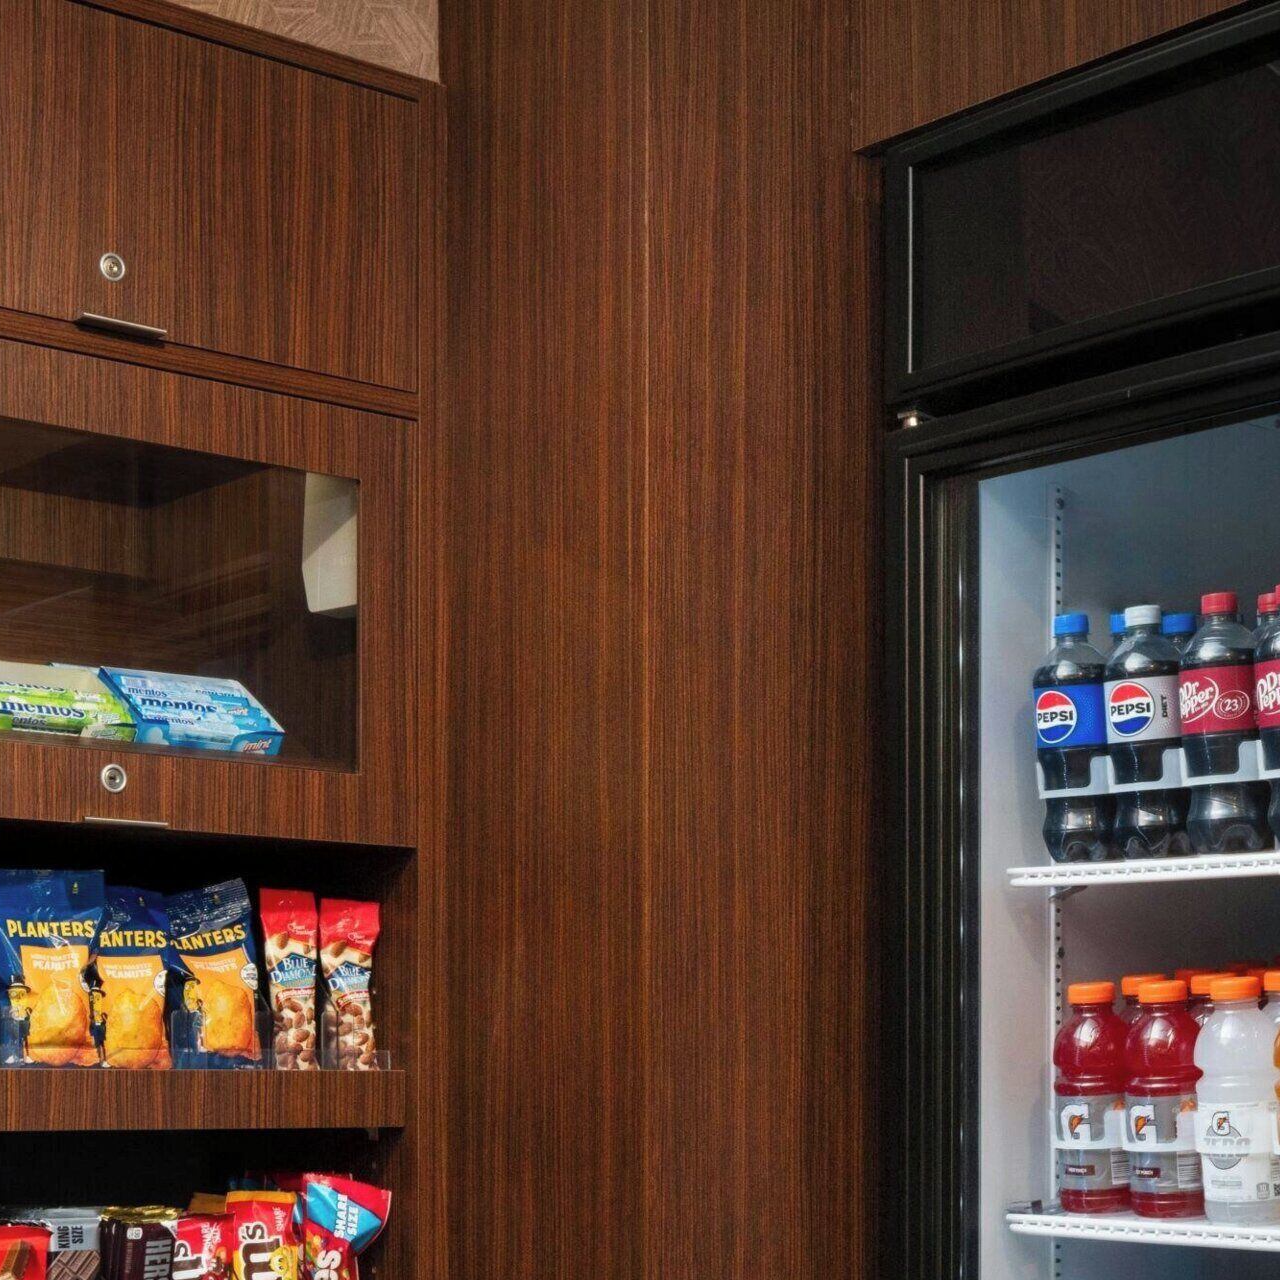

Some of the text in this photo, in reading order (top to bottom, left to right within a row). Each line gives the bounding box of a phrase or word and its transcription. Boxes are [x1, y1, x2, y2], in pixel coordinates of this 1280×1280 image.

[0, 700, 84, 719] mentos
[1111, 701, 1151, 716] PEPSI
[1226, 699, 1239, 709] 23
[1038, 709, 1073, 723] PEPSI
[6, 919, 94, 939] PLANTERS
[282, 957, 309, 970] BLUE
[334, 1194, 348, 1238] SHARE
[347, 1205, 360, 1236] SIZE
[57, 1225, 69, 1248] KING
